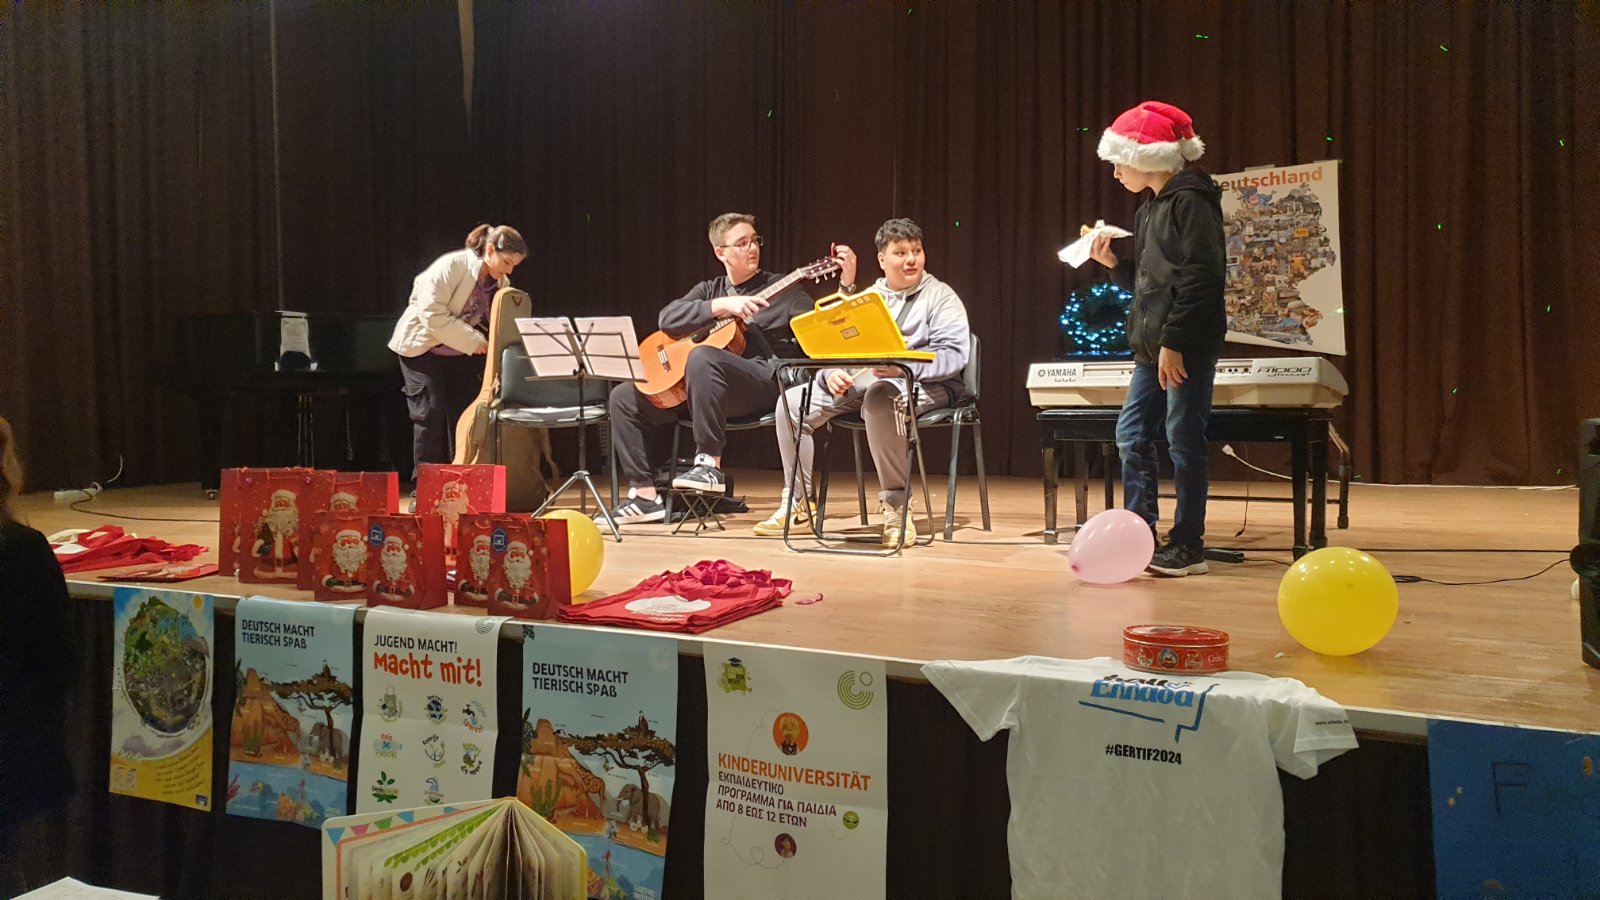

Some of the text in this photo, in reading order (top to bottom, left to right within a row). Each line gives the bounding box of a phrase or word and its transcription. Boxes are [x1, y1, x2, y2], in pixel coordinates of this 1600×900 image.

[1047, 368, 1077, 377] YAMAHA
[242, 619, 315, 637] DEUTSCH MACHT
[242, 632, 281, 647] TIERISCH
[374, 634, 458, 654] JUGEND MACHT!
[373, 651, 482, 687] Macht mit!
[532, 662, 629, 684] DEUTSCH MACHT
[532, 677, 584, 694] TIERISCH
[1105, 744, 1182, 765] #GERTIF2024
[718, 752, 871, 791] KINDERUNIVERSITÄT
[718, 771, 784, 795] ΕΚΠΑΙΔΕΥΤΙΚΟ
[717, 785, 837, 816] ΠΡΟΓΡΑΜΜΑ ΓΙΑ ΠΑΙΔΙΑ
[716, 799, 807, 827] ΑΠΟ 8 ΕΩΣ 12 ΕΤΩΝ
